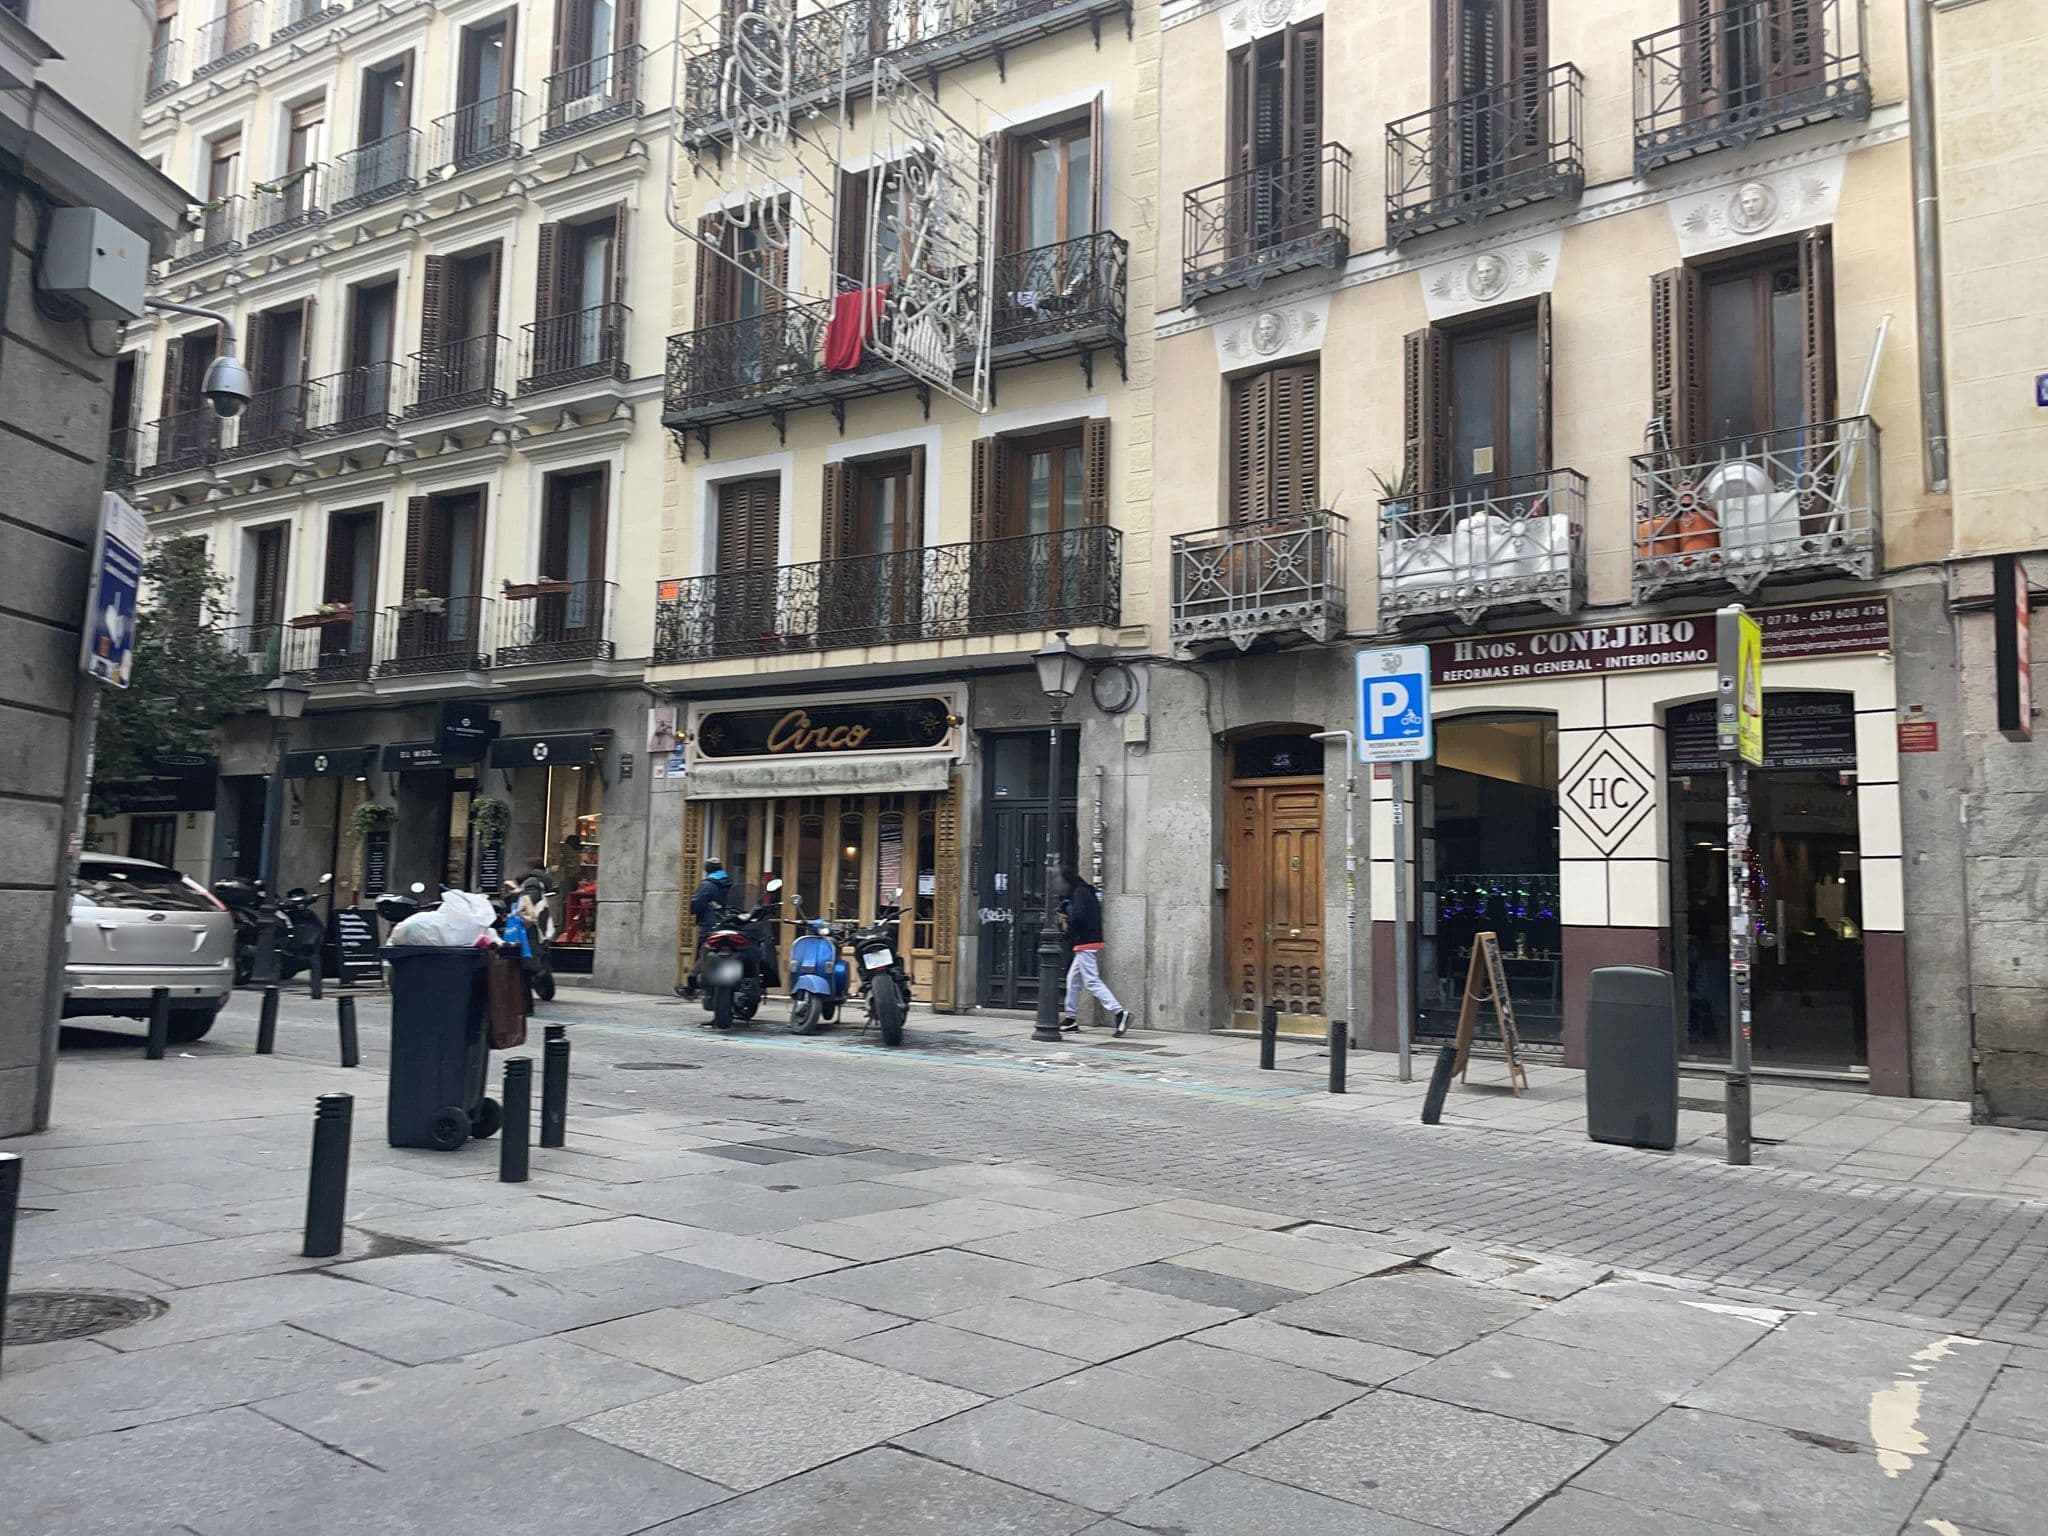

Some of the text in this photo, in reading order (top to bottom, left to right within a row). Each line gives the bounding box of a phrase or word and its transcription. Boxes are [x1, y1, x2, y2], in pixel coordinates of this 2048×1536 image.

[1766, 614, 1781, 624] 07
[1784, 614, 1799, 624] 76
[1810, 610, 1833, 621] 639
[1862, 605, 1886, 616] 476
[1530, 620, 1695, 655] CONEJERO
[1443, 665, 1509, 682] REFORMAS
[1513, 664, 1531, 676] EN
[1534, 659, 1593, 674] GENERAL
[1605, 649, 1709, 668] INTERIORISMO
[1370, 681, 1409, 735] P
[1588, 777, 1630, 809] HC
